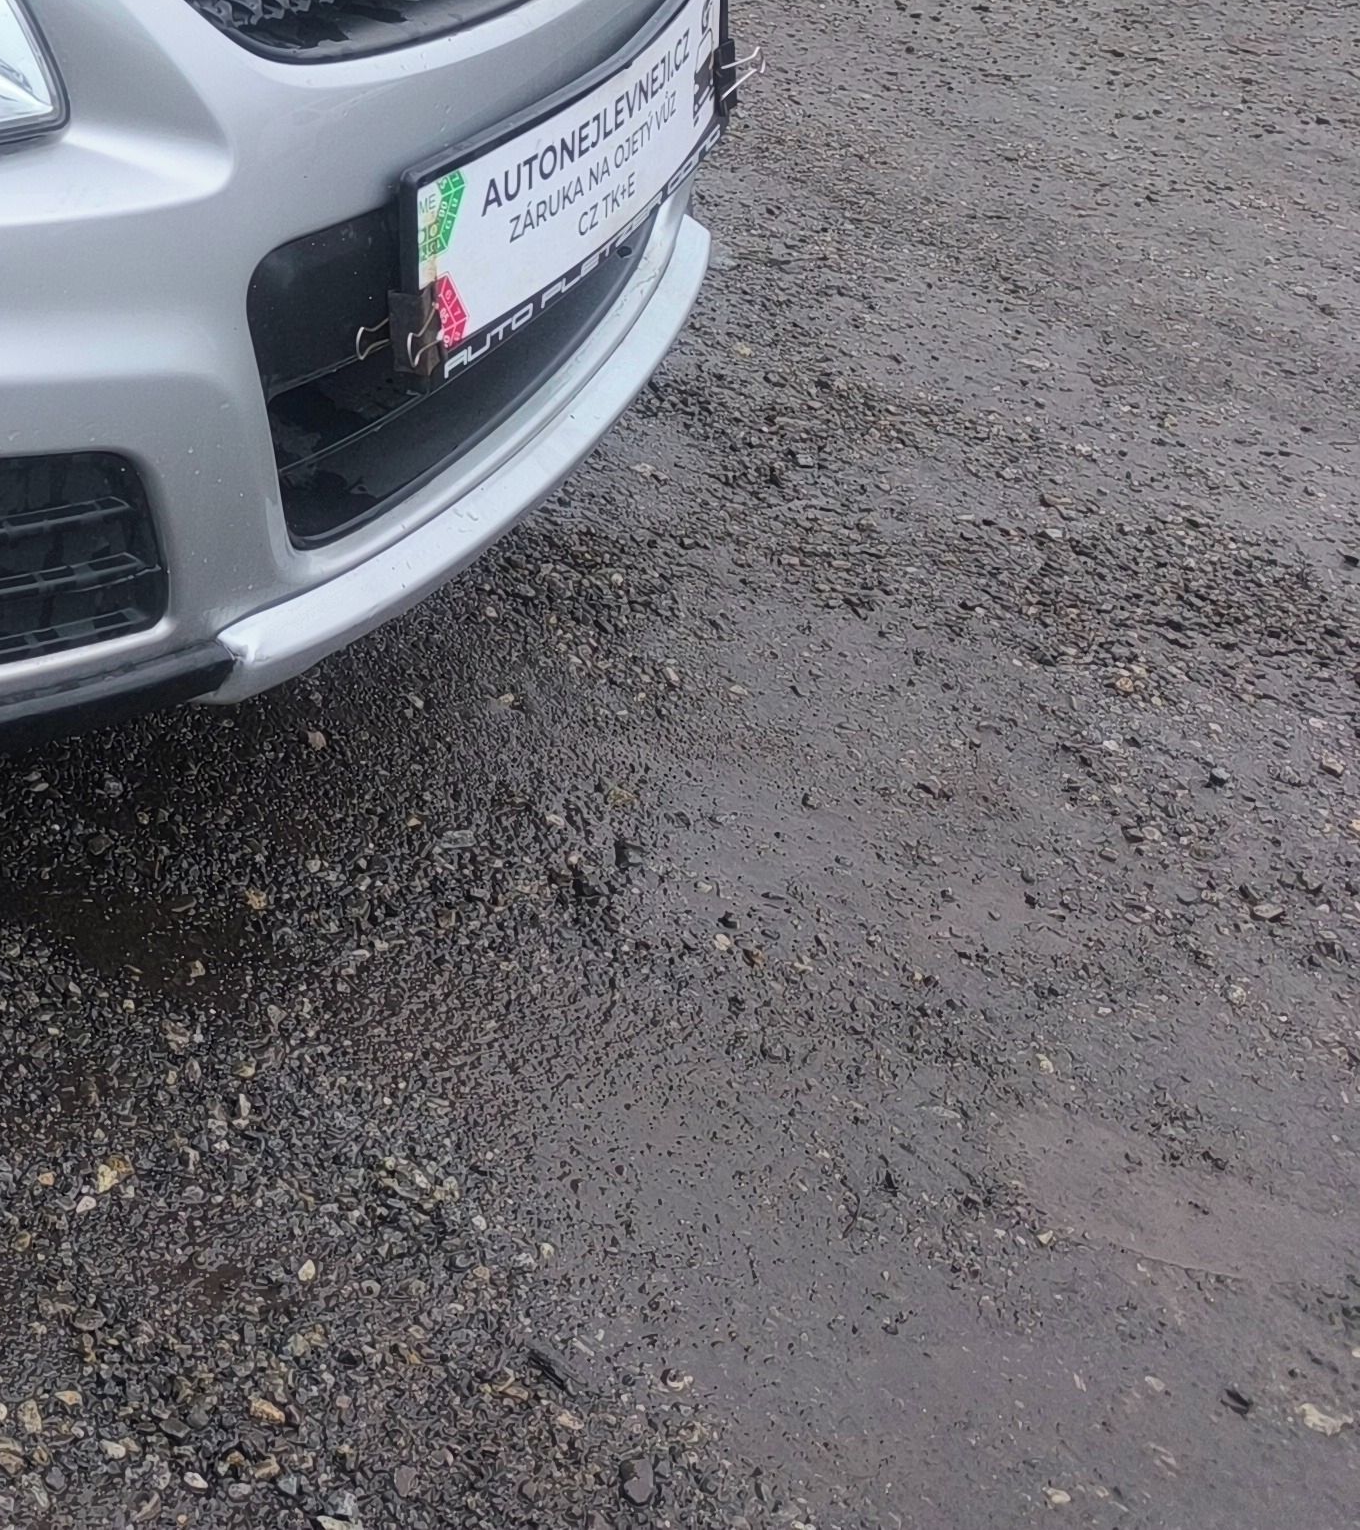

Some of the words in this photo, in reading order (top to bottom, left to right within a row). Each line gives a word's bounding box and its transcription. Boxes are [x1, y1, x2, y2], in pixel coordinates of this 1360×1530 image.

[481, 27, 690, 218] AUTONEJLEVNEJI.CZ
[509, 175, 584, 244] ZÁRUKA
[588, 156, 611, 191] NA
[614, 111, 653, 169] OJETÝ
[655, 90, 677, 131] VŮZ
[578, 201, 599, 236] CZ
[602, 171, 636, 219] TK+E
[444, 303, 533, 379] AUTO
[541, 190, 663, 308] PLETZER
